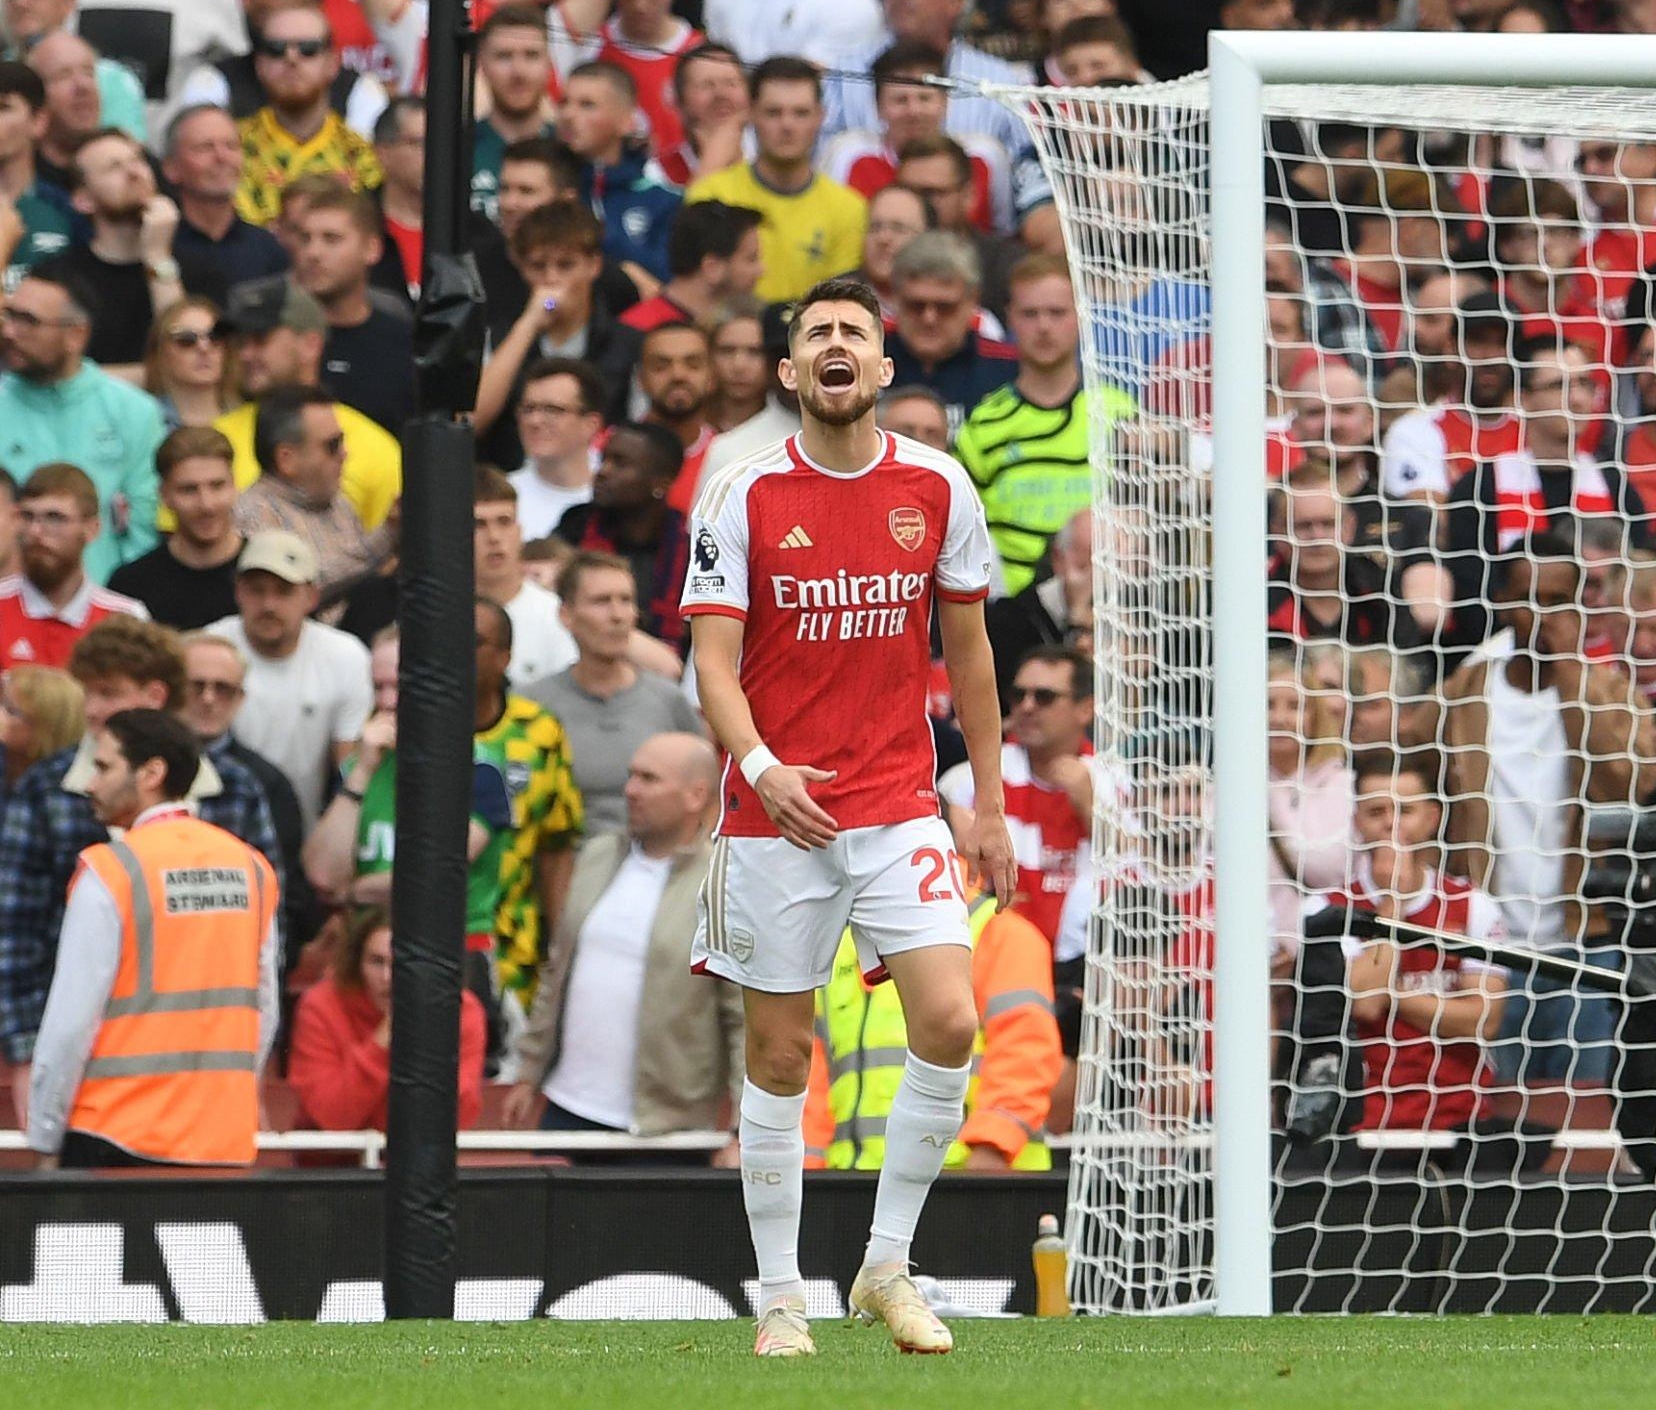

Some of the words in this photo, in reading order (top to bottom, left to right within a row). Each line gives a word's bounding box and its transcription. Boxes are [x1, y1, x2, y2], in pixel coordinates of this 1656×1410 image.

[770, 568, 929, 609] Emirates
[796, 612, 834, 642] FLY
[838, 606, 908, 641] BETTER
[166, 868, 247, 886] ARSENAL
[167, 894, 249, 912] STEWARD
